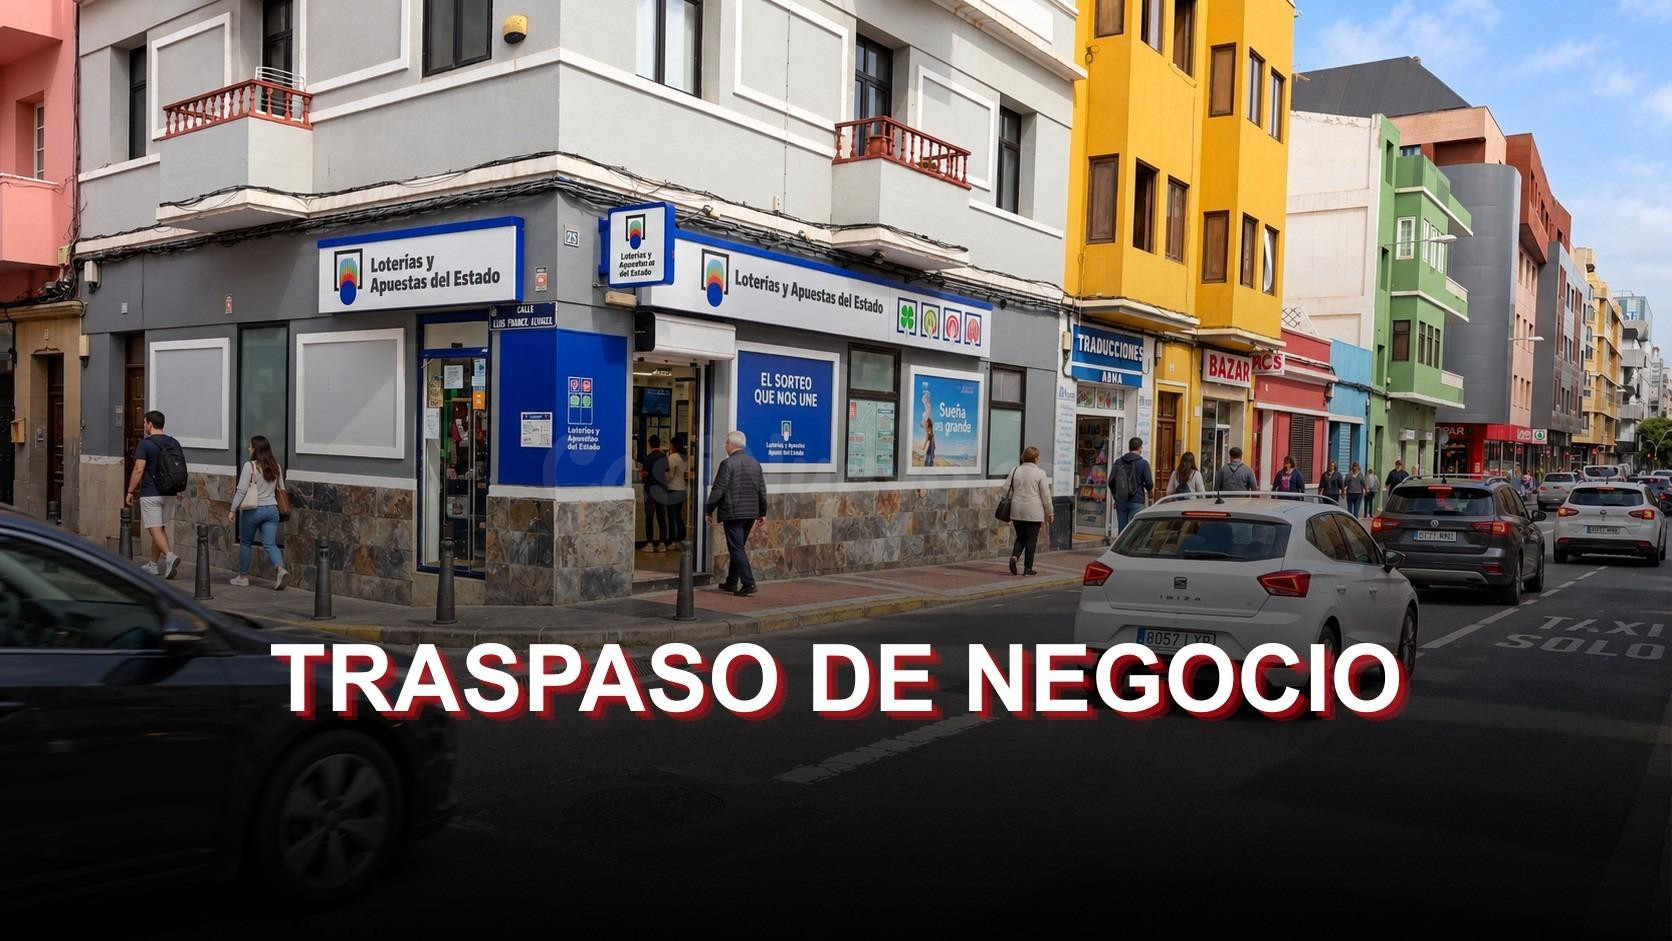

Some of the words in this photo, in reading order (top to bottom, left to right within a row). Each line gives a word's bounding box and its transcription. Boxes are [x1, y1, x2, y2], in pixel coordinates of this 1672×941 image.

[370, 253, 423, 273] Loterías
[426, 255, 435, 271] y
[630, 268, 652, 277] Estado
[370, 272, 427, 296] Apuestas
[430, 271, 450, 288] del
[454, 268, 500, 287] Estado
[735, 269, 780, 294] Loterías
[782, 282, 789, 298] y
[791, 281, 836, 305] Apuestas
[838, 291, 852, 308] del
[854, 295, 884, 314] Estado
[516, 305, 535, 314] CALLE
[1078, 334, 1144, 362] TRADUCCIONES
[1209, 354, 1250, 382] BAZAR
[761, 372, 772, 387] EL
[775, 373, 812, 390] SORTEO
[754, 389, 774, 405] QUE
[777, 391, 797, 406] NOS
[799, 393, 818, 407] UNE
[944, 420, 972, 437] grande
[1540, 616, 1664, 638] TAXI
[1147, 631, 1179, 646] 8057
[1494, 634, 1666, 660] SOLO
